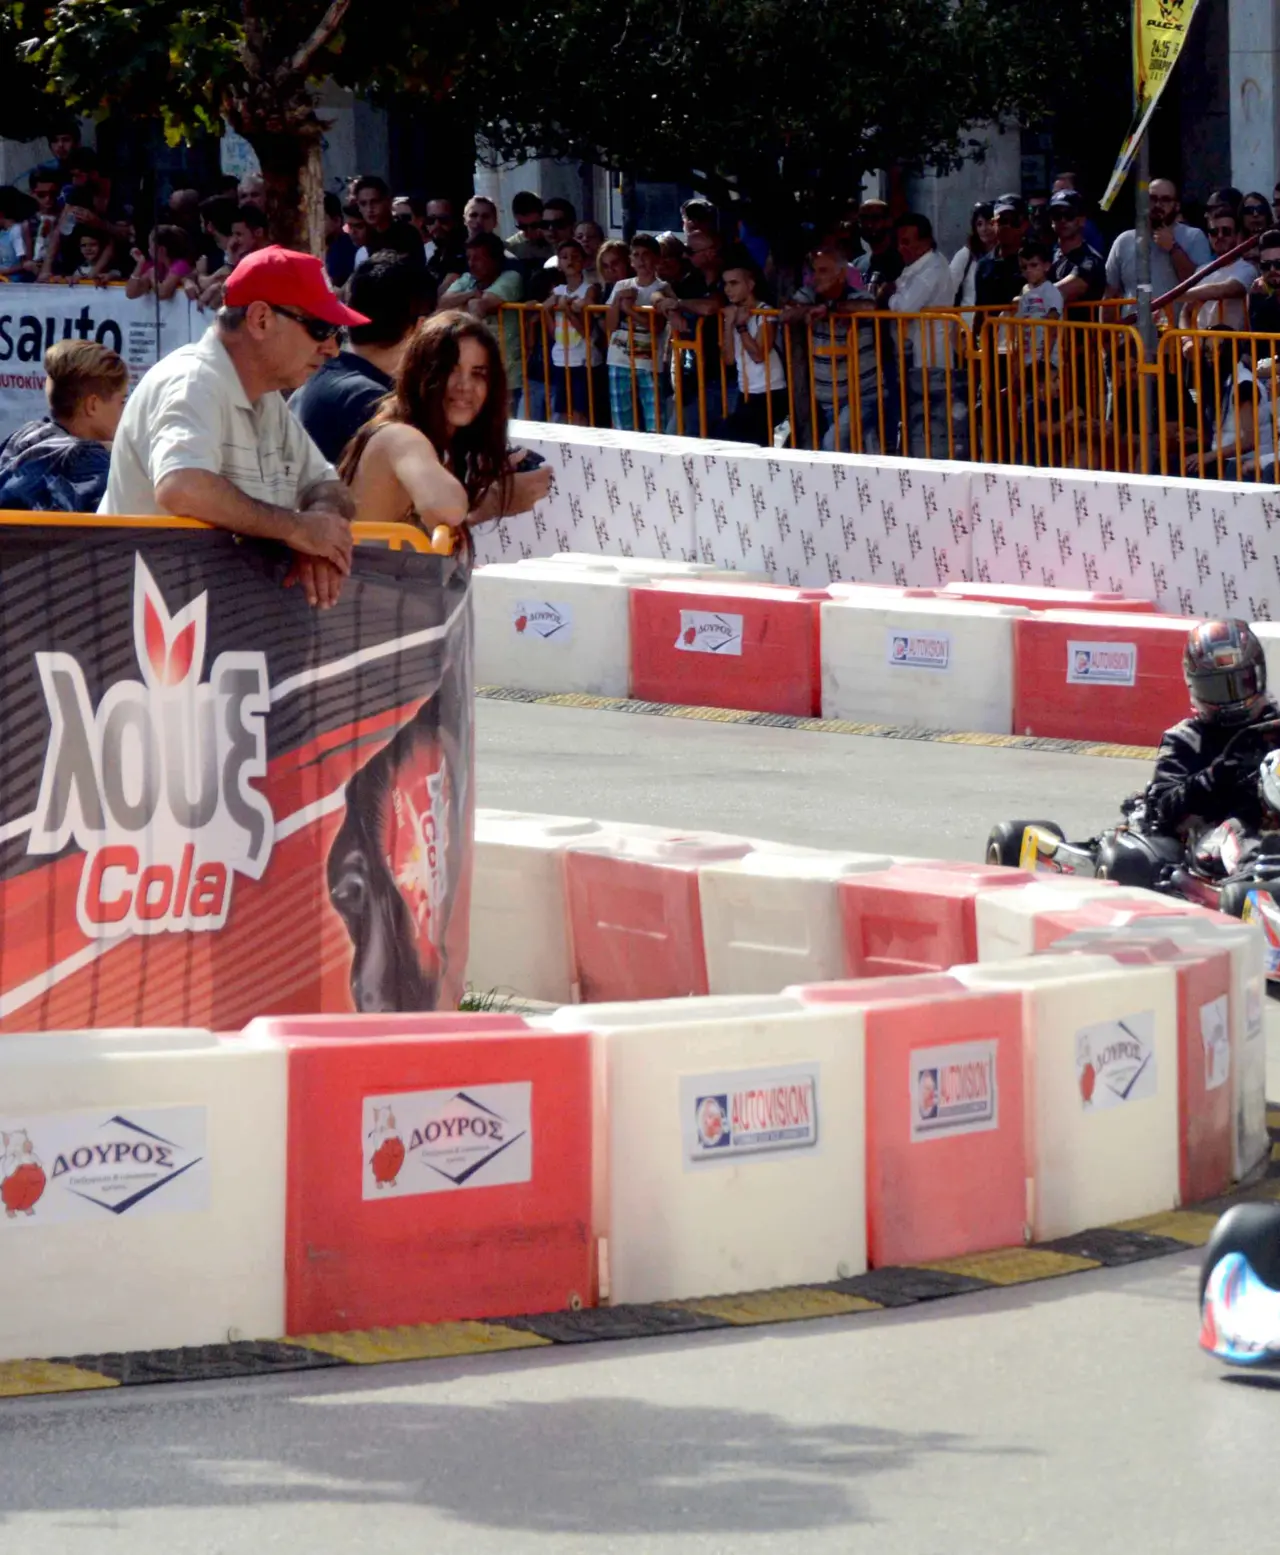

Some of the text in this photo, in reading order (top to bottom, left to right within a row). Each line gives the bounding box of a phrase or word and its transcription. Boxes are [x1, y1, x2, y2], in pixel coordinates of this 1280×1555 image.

[84, 843, 229, 925] Cola
[941, 1061, 987, 1105] AUTOVISION
[731, 1084, 811, 1132] AUTOVISION
[408, 1116, 504, 1152] ΔΟΥΡΟΣ
[51, 1141, 175, 1179] ΔΟΥΡΟΣ
